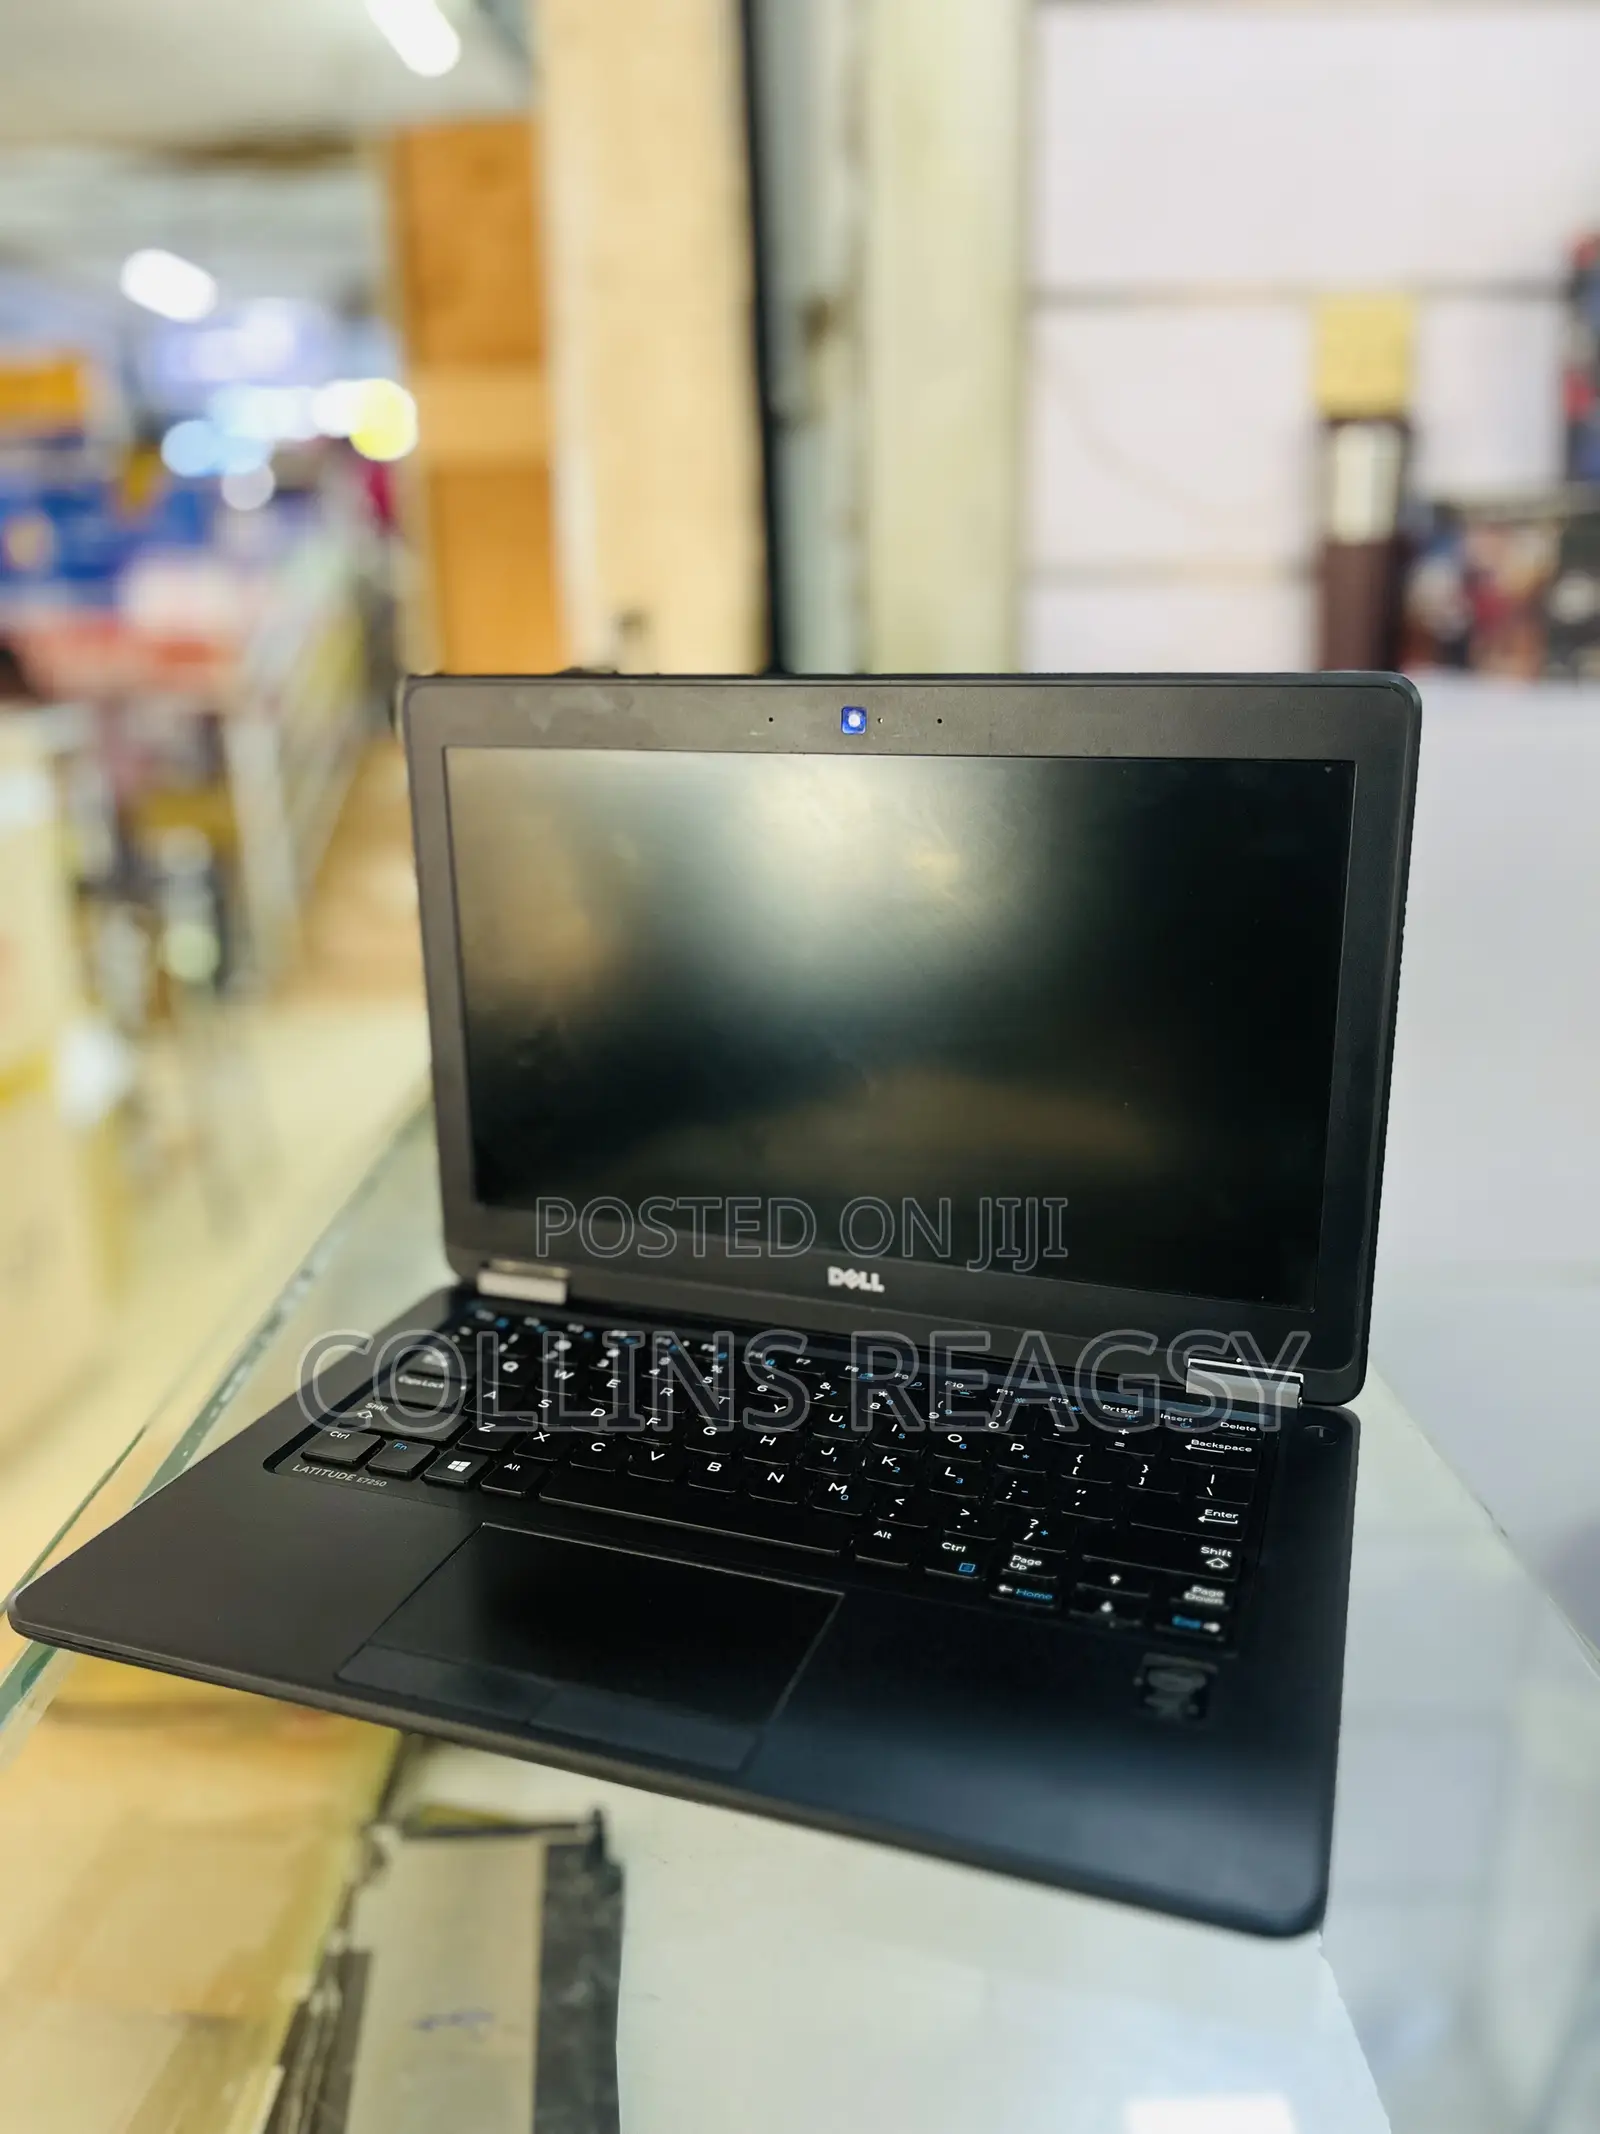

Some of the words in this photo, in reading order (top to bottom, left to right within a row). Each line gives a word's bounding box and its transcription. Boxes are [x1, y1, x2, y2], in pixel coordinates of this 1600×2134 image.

[827, 1266, 885, 1293] DELL
[845, 1365, 860, 1373] F8
[554, 1369, 575, 1380] W
[606, 1378, 621, 1388] E
[820, 1382, 831, 1391] &
[945, 1381, 964, 1389] F10
[483, 1390, 497, 1400] A
[659, 1387, 674, 1396] R
[996, 1388, 1014, 1396] F11
[538, 1398, 552, 1408] S
[718, 1395, 731, 1405] T
[1049, 1397, 1069, 1405] F12
[365, 1402, 388, 1412] Shift
[773, 1404, 786, 1413] Y
[870, 1402, 881, 1410] 8
[1102, 1404, 1140, 1416] PrtScr
[590, 1407, 606, 1417] D
[928, 1411, 940, 1419] 9
[646, 1417, 661, 1426] F
[828, 1413, 844, 1423] U
[1160, 1412, 1193, 1424] Insert
[478, 1422, 496, 1433] Z
[702, 1426, 718, 1436] G
[1220, 1421, 1257, 1432] Delete
[329, 1430, 350, 1440] Ctrl
[532, 1431, 550, 1442] X
[947, 1434, 963, 1443] O
[760, 1435, 776, 1446] H
[1191, 1438, 1252, 1453] Backspace
[393, 1442, 408, 1451] Fn
[591, 1442, 606, 1451] C
[820, 1447, 835, 1456] J
[1010, 1443, 1025, 1452] P
[650, 1451, 665, 1461] V
[881, 1456, 897, 1466] K
[504, 1462, 521, 1471] Alt
[707, 1461, 722, 1472] B
[944, 1466, 956, 1477] L
[292, 1464, 356, 1482] LATITUDE
[356, 1476, 387, 1487] E7250
[767, 1471, 785, 1483] N
[828, 1482, 848, 1494] M
[1204, 1508, 1239, 1519] Enter
[873, 1529, 892, 1540] Alt
[941, 1542, 966, 1553] Ctrl
[1200, 1546, 1232, 1558] Shift
[1012, 1554, 1042, 1566] Page
[1009, 1561, 1027, 1571] Up
[1015, 1588, 1053, 1600] Home
